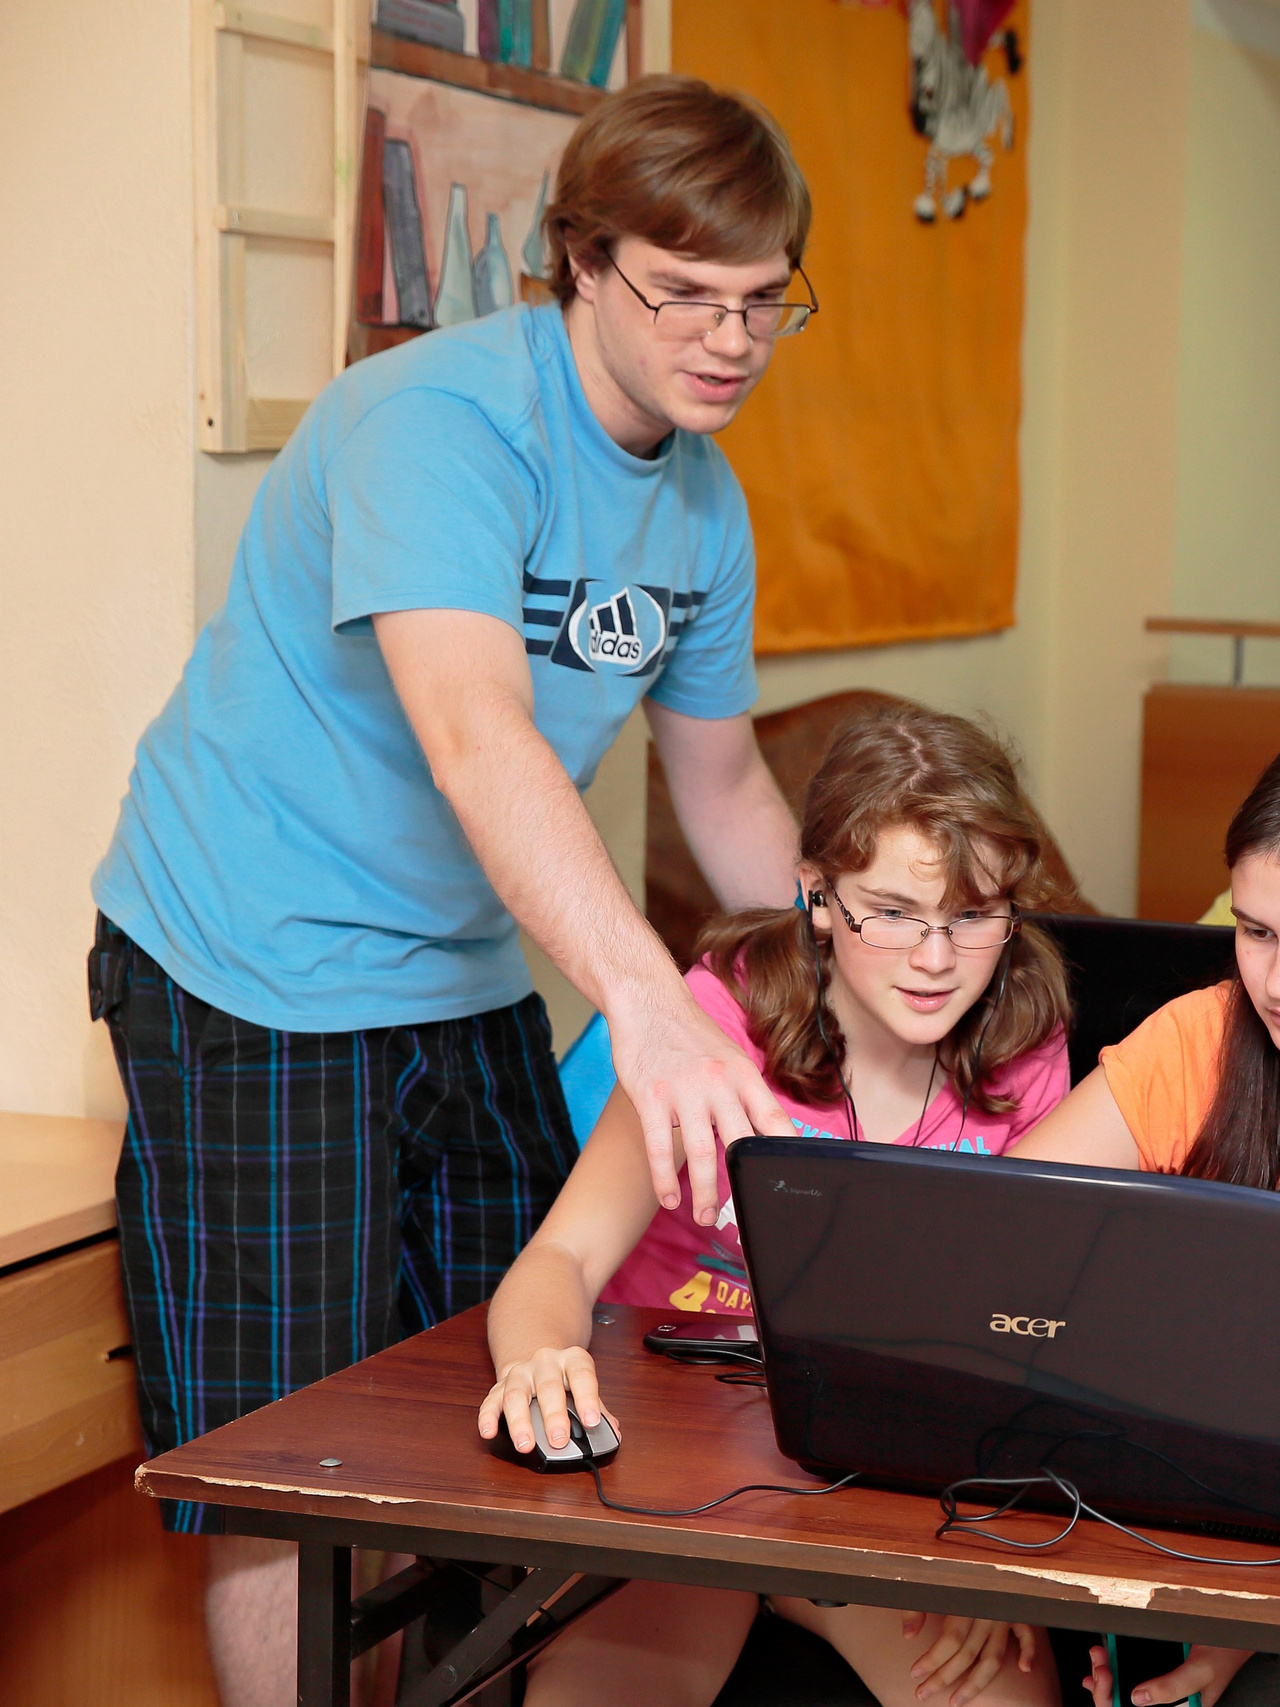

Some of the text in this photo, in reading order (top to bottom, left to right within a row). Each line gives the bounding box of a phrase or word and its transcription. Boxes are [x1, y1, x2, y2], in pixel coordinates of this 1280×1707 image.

[590, 630, 640, 659] didas
[716, 1280, 753, 1313] DAY
[989, 1313, 1067, 1339] acer
